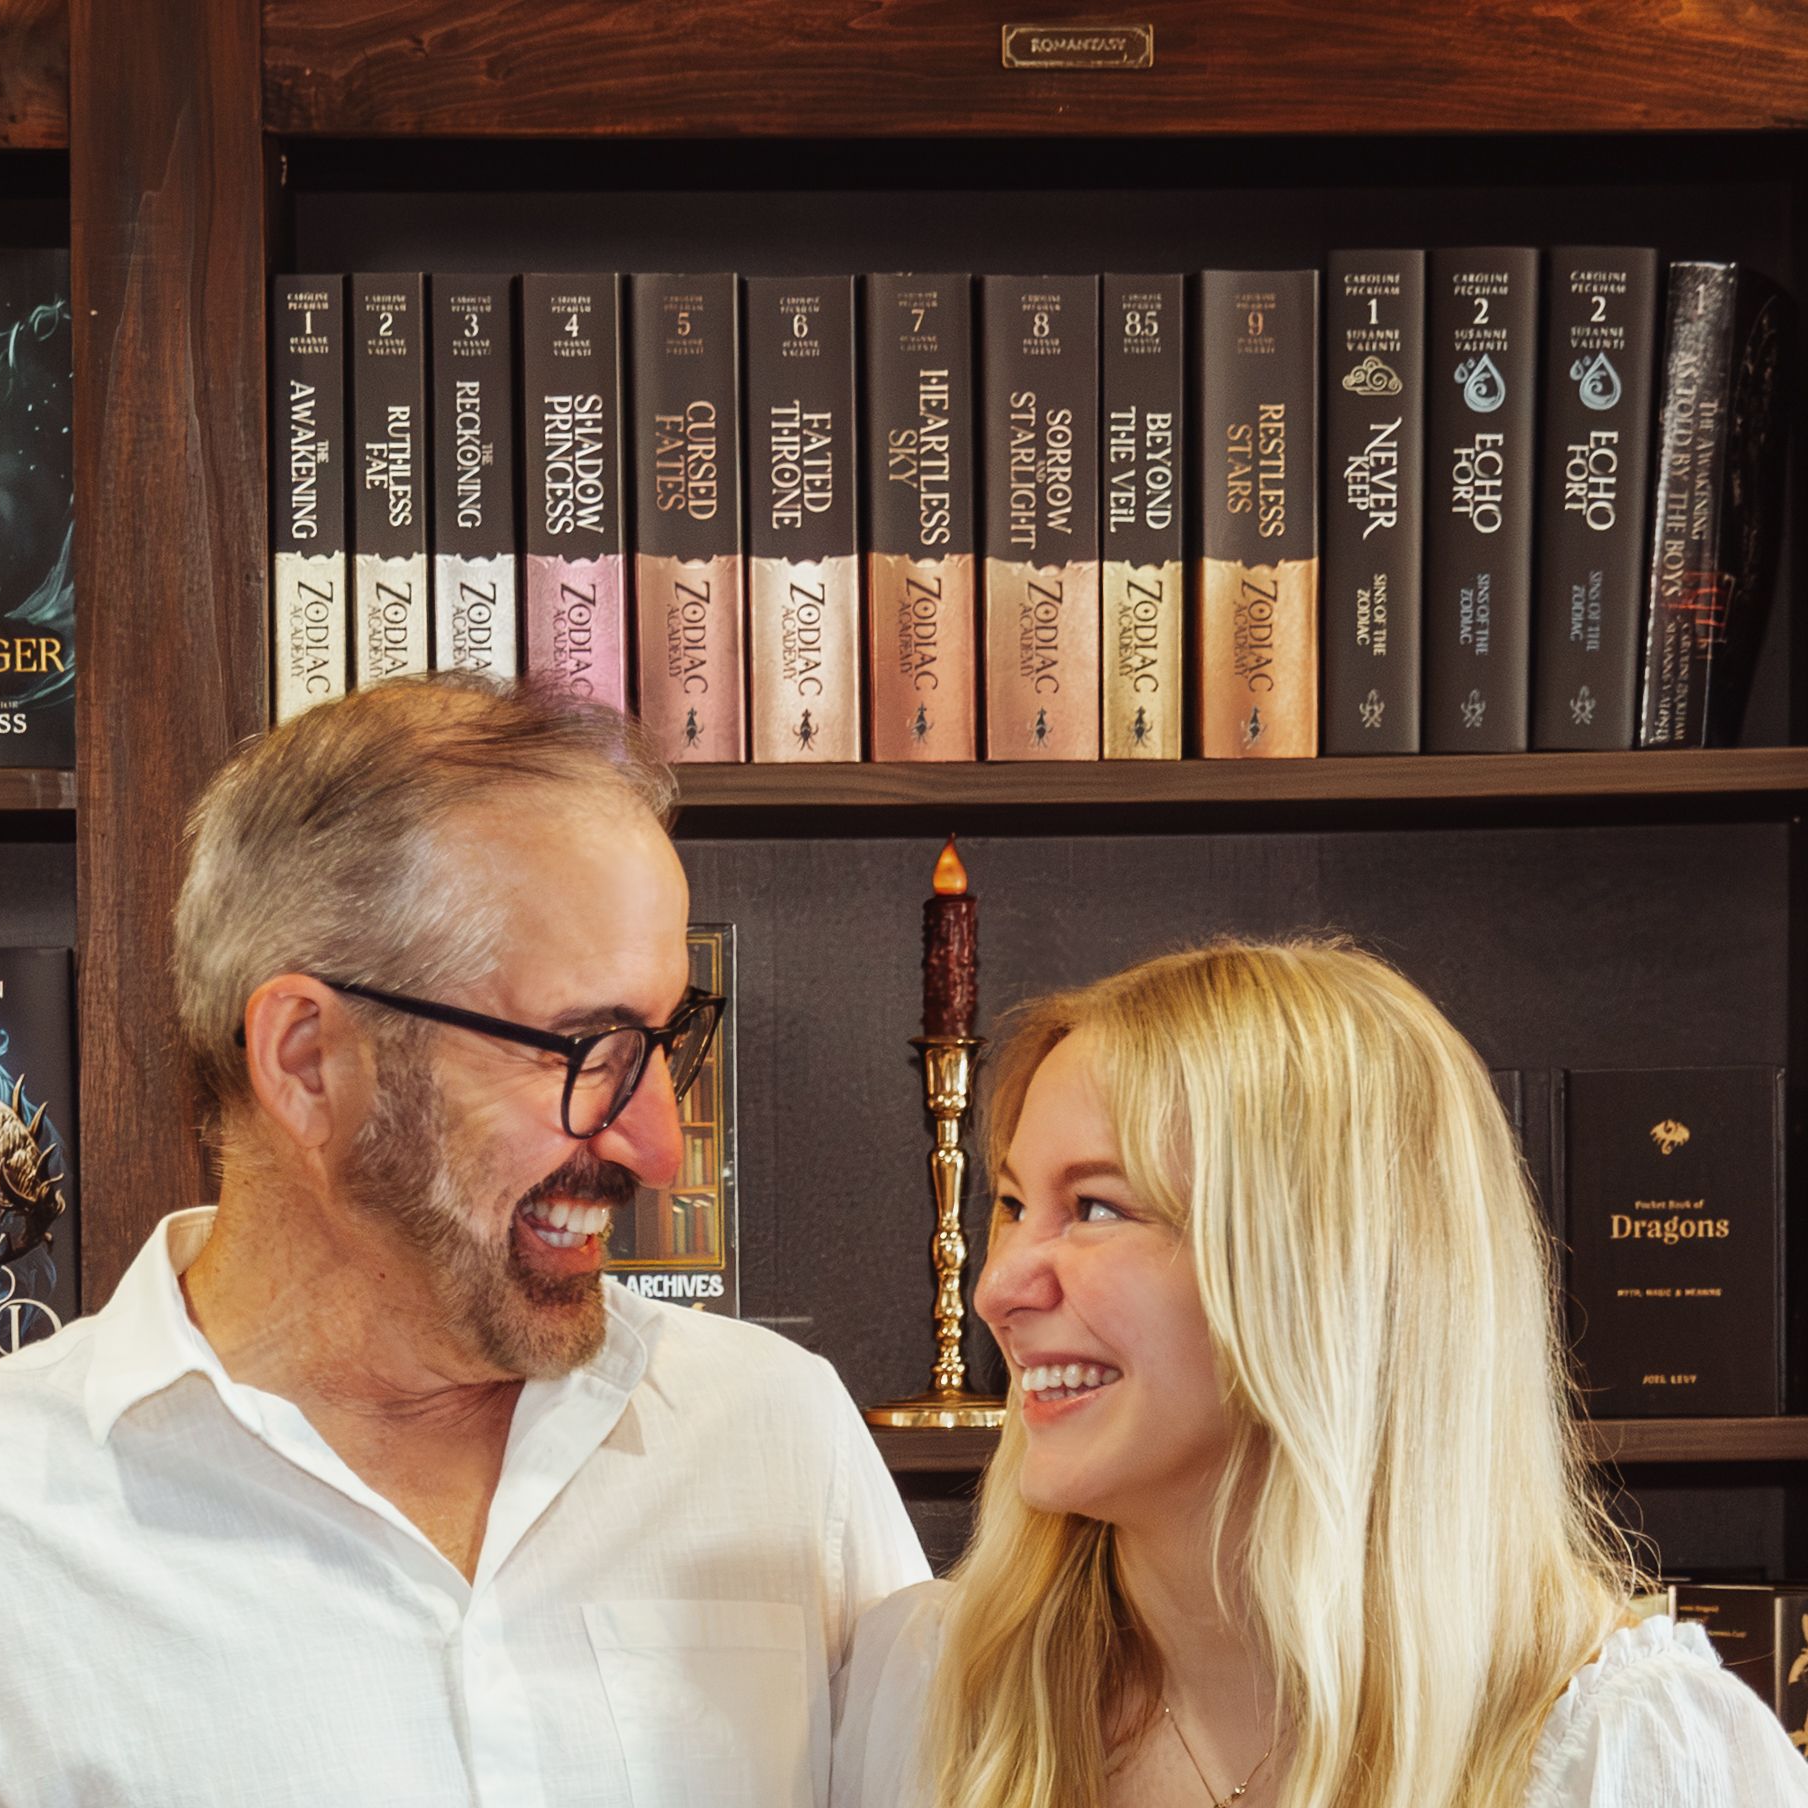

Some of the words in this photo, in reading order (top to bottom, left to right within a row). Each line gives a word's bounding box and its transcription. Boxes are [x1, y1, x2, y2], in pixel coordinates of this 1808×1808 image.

[1030, 38, 1127, 53] ROMANTASY
[1344, 273, 1400, 284] CAROLINE
[1345, 285, 1400, 296] PECKHAM
[304, 313, 313, 334] 1
[380, 313, 393, 335] 2
[464, 314, 479, 337] 3
[565, 315, 579, 337] 4
[793, 315, 808, 338] 6
[911, 310, 924, 333] 7
[1033, 313, 1049, 337] 8
[1125, 312, 1158, 337] 8.5
[1248, 312, 1262, 336] 9
[1347, 330, 1399, 340] SUSANNE
[1368, 301, 1379, 325] 1
[1473, 300, 1489, 324] 2
[1347, 341, 1400, 352] VALENTI
[290, 379, 317, 540] AWAKENING
[457, 381, 481, 528] RECKONING
[575, 394, 604, 534] SHADOW
[656, 414, 684, 512] FATES
[687, 400, 717, 521] CURSED
[803, 410, 832, 513] FATED
[888, 429, 918, 489] SKY
[919, 370, 949, 545] HEARTLESS
[1110, 406, 1136, 465] THE
[366, 442, 388, 489] FAE
[388, 405, 411, 527] RUTHLESS
[545, 395, 574, 535] PRINCESS
[771, 401, 801, 530] THRONE
[1010, 391, 1036, 550] STARLIGHT
[1046, 409, 1073, 535] SORROW
[1146, 411, 1172, 531] BEYOND
[1227, 424, 1252, 514] STARS
[1259, 402, 1286, 539] RESTLESS
[1343, 456, 1369, 511] KEEP
[1363, 417, 1402, 540] NEVER
[1453, 448, 1475, 517] FORT
[1472, 432, 1503, 534] ECHO
[1110, 473, 1135, 532] VEIL
[1610, 1214, 1729, 1245] Dragons
[1635, 1200, 1666, 1209] Pocket
[1668, 1200, 1691, 1210] Book
[1694, 1200, 1705, 1209] of
[625, 1273, 724, 1298] ARCHIVES
